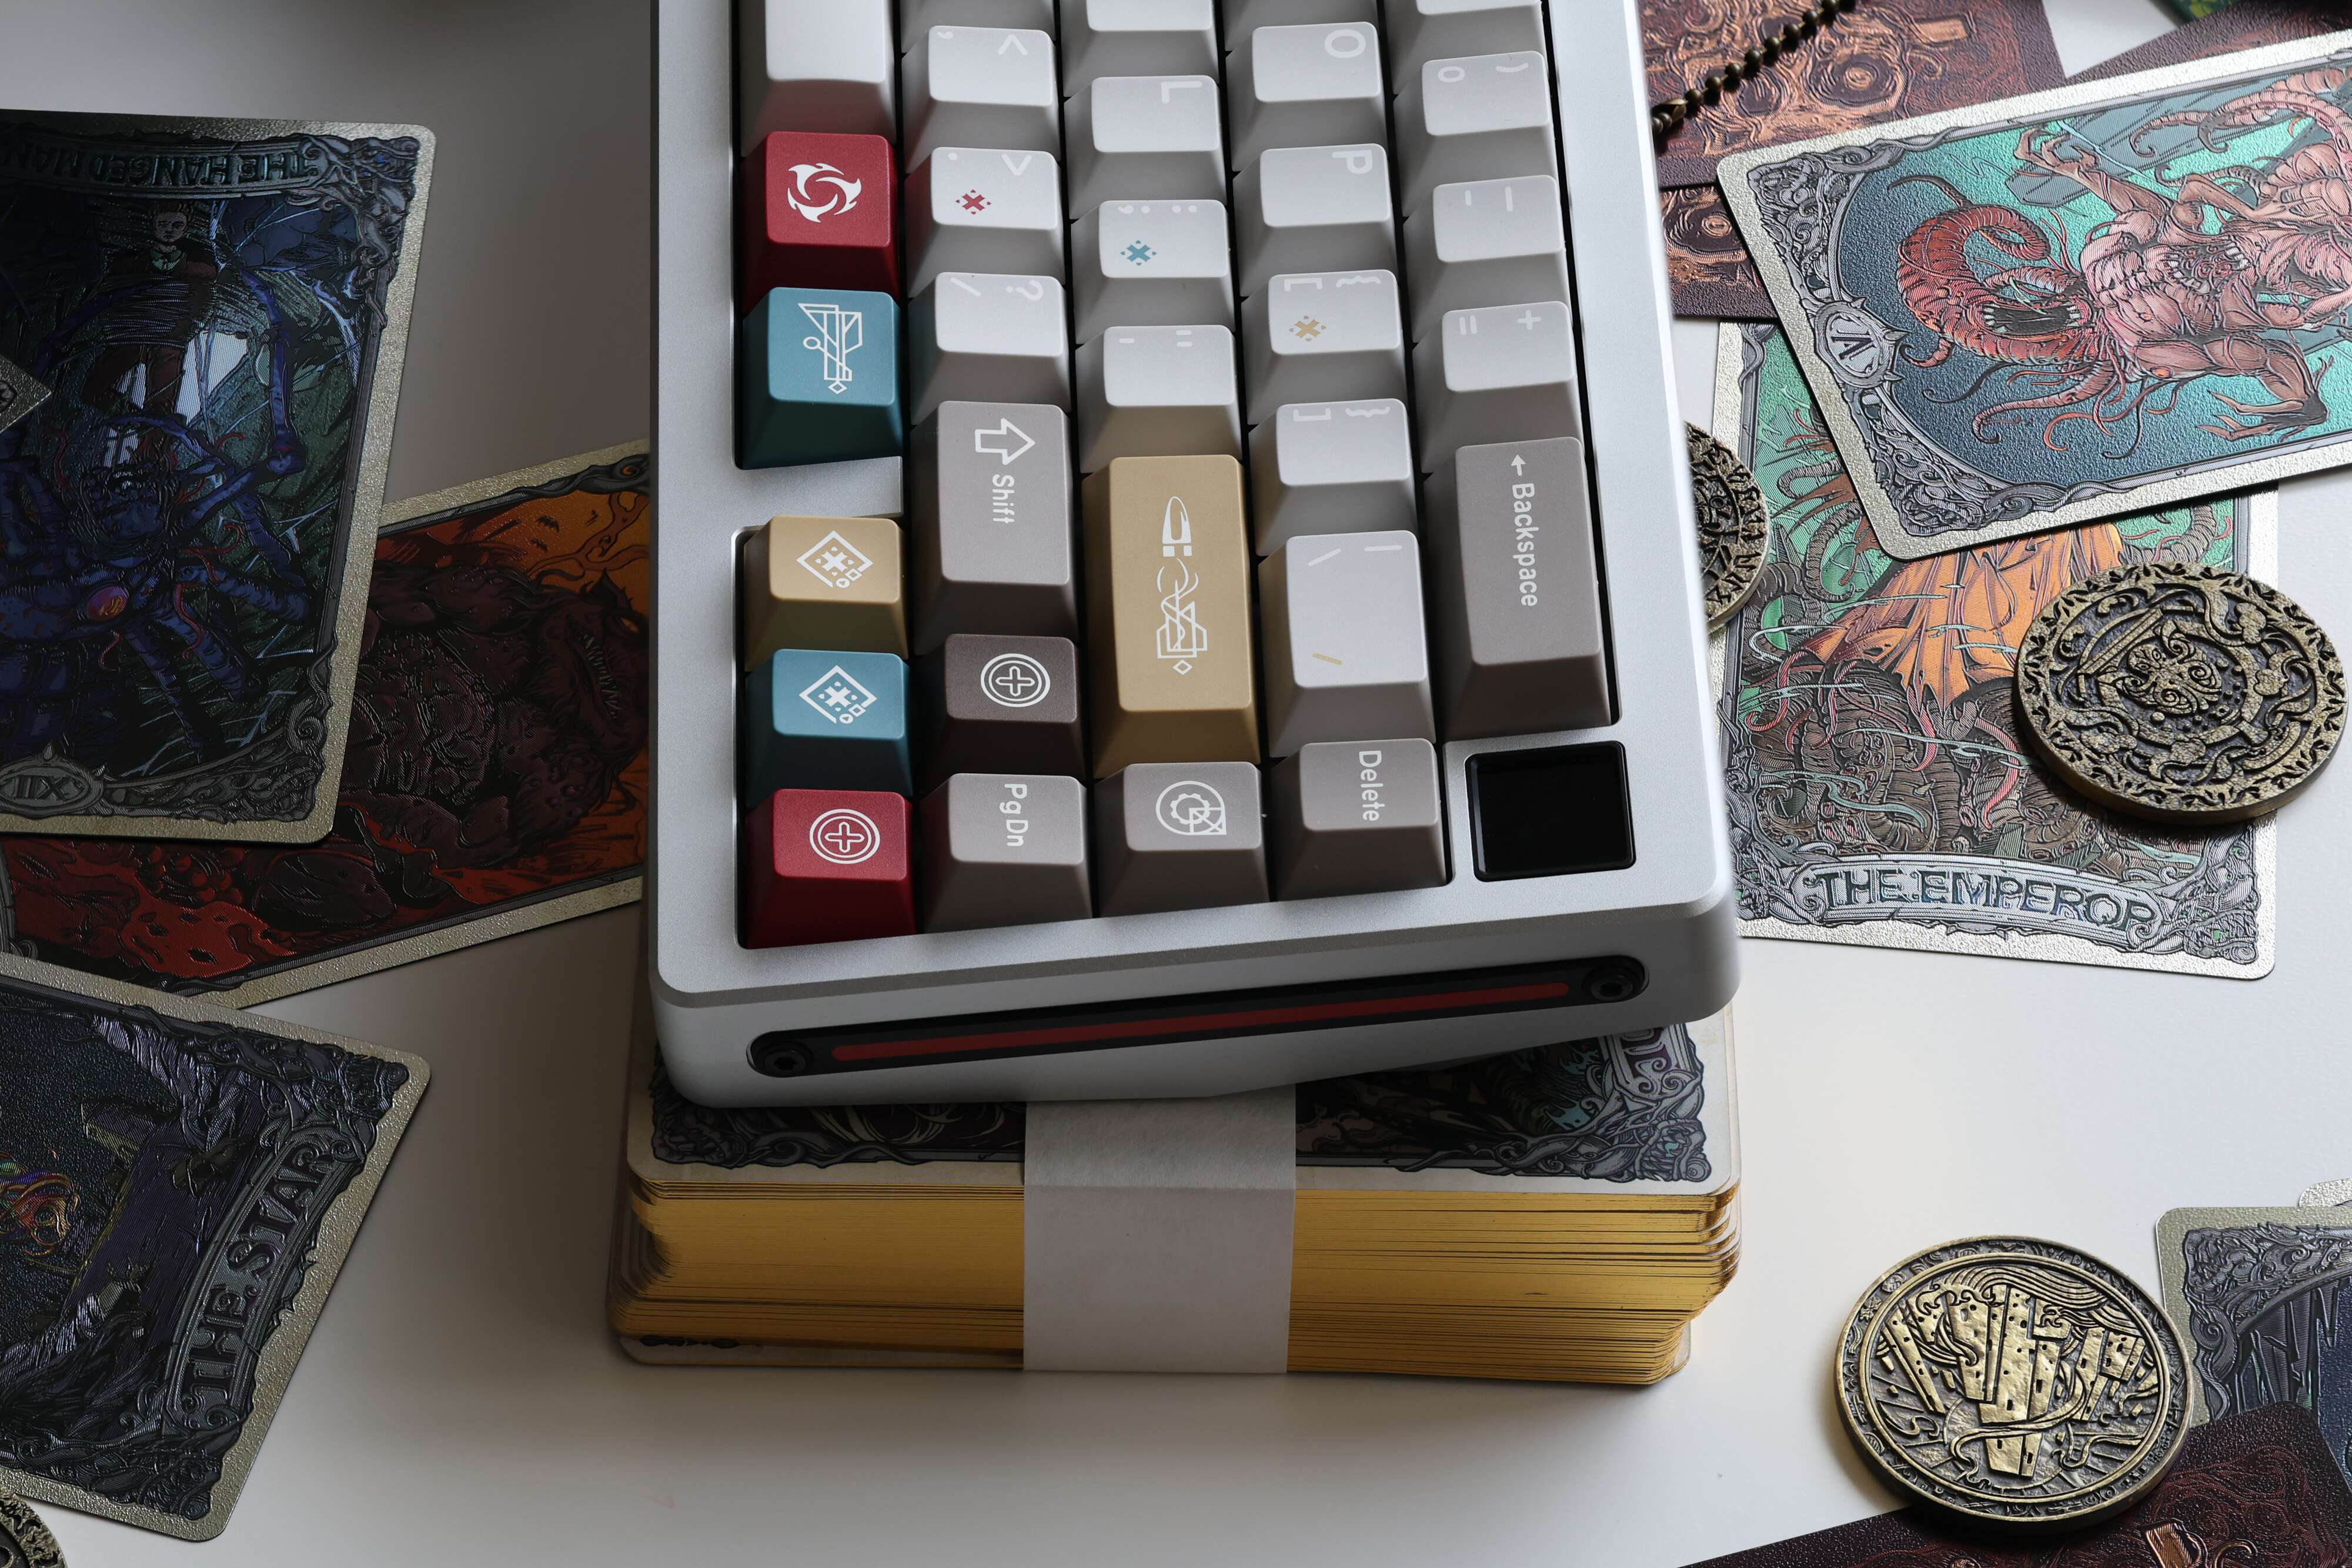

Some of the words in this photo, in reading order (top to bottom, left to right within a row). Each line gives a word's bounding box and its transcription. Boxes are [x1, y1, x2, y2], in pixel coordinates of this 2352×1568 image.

[1324, 29, 1367, 58] O
[1161, 81, 1202, 104] L
[238, 154, 318, 185] THE
[1332, 149, 1372, 174] P
[1006, 280, 1044, 301] ?
[992, 474, 1015, 524] Shift
[1512, 483, 1540, 607] Backspace
[999, 783, 1028, 814] Pg
[1358, 750, 1385, 821] Delete
[1006, 819, 1029, 847] Dn
